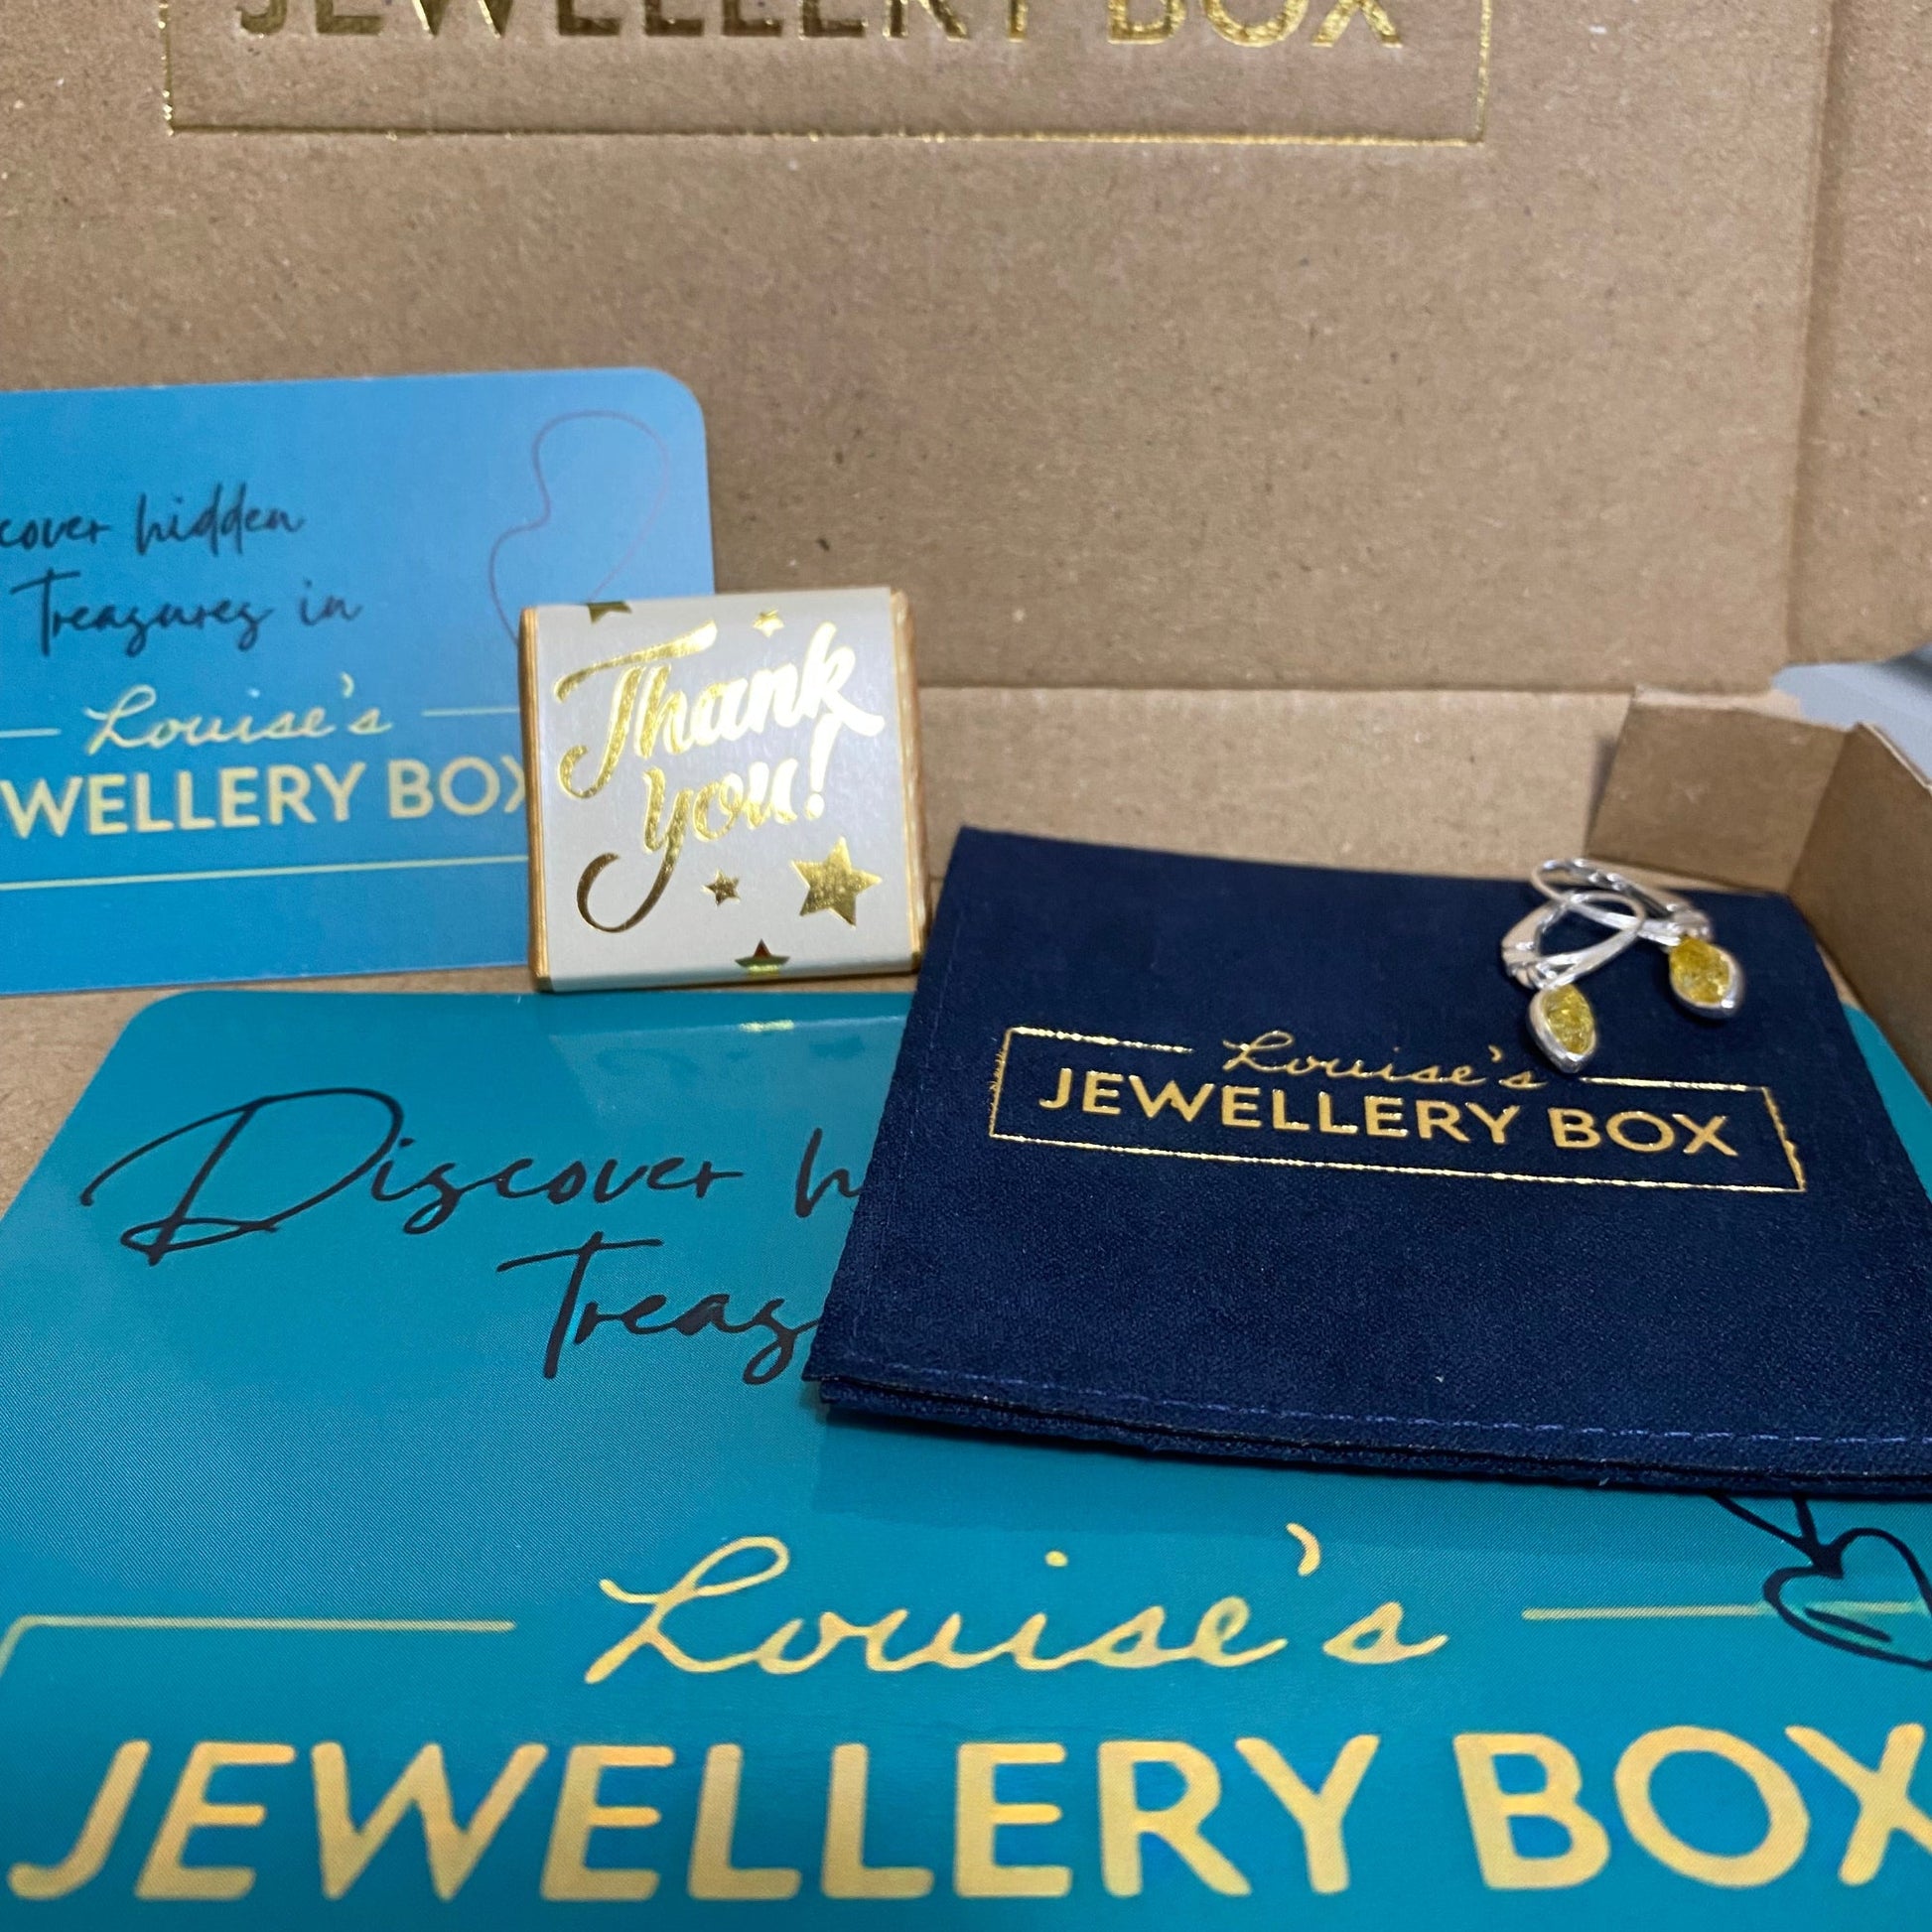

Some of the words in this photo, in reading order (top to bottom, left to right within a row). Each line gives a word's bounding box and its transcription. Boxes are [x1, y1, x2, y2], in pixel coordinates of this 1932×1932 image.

[0, 515, 110, 549] cover
[136, 483, 305, 556] hidden
[10, 567, 275, 657] Treasures
[300, 579, 363, 625] in
[82, 671, 394, 756] Louise's
[553, 620, 886, 799] Thank
[0, 761, 367, 839] WELLERY
[576, 711, 825, 933] you!
[1038, 1067, 1520, 1145] JEWELLERY
[1549, 1107, 1739, 1158] BOX
[1222, 1030, 1548, 1089] Louise's
[80, 1087, 745, 1266] Discover
[496, 1230, 821, 1386] Treas
[585, 1522, 1449, 1684] Louise's
[8, 1733, 1381, 1903] JEWELLERY
[1452, 1723, 1932, 1893] BOX
